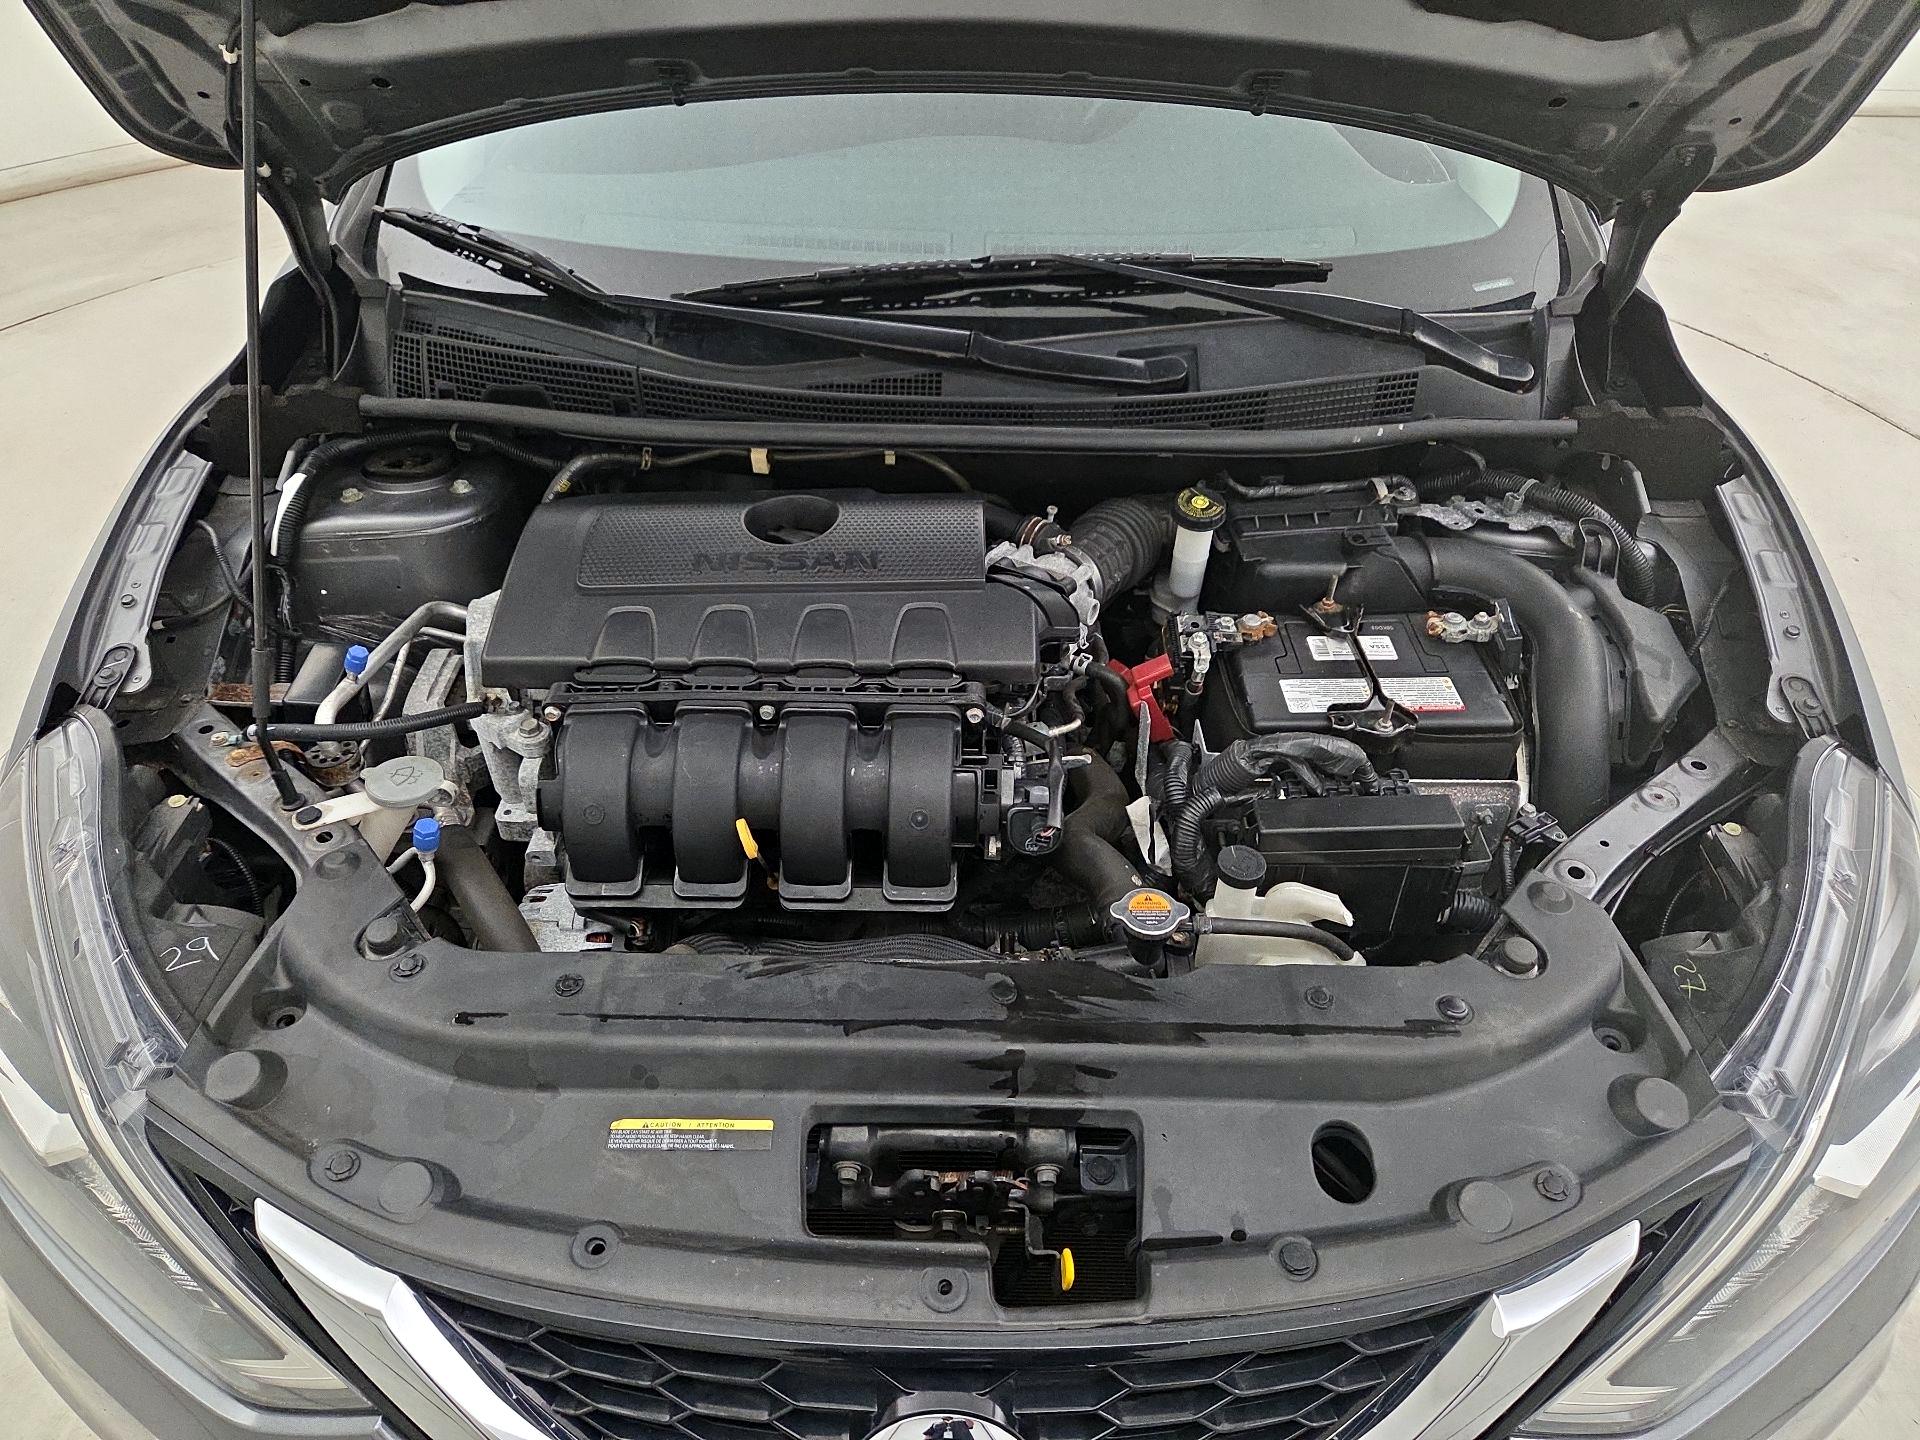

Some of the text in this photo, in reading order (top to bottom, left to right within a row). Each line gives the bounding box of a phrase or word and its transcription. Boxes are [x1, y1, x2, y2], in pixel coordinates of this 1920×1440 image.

[694, 550, 879, 573] NISSAN
[160, 936, 220, 972] 29
[1673, 958, 1707, 999] 27
